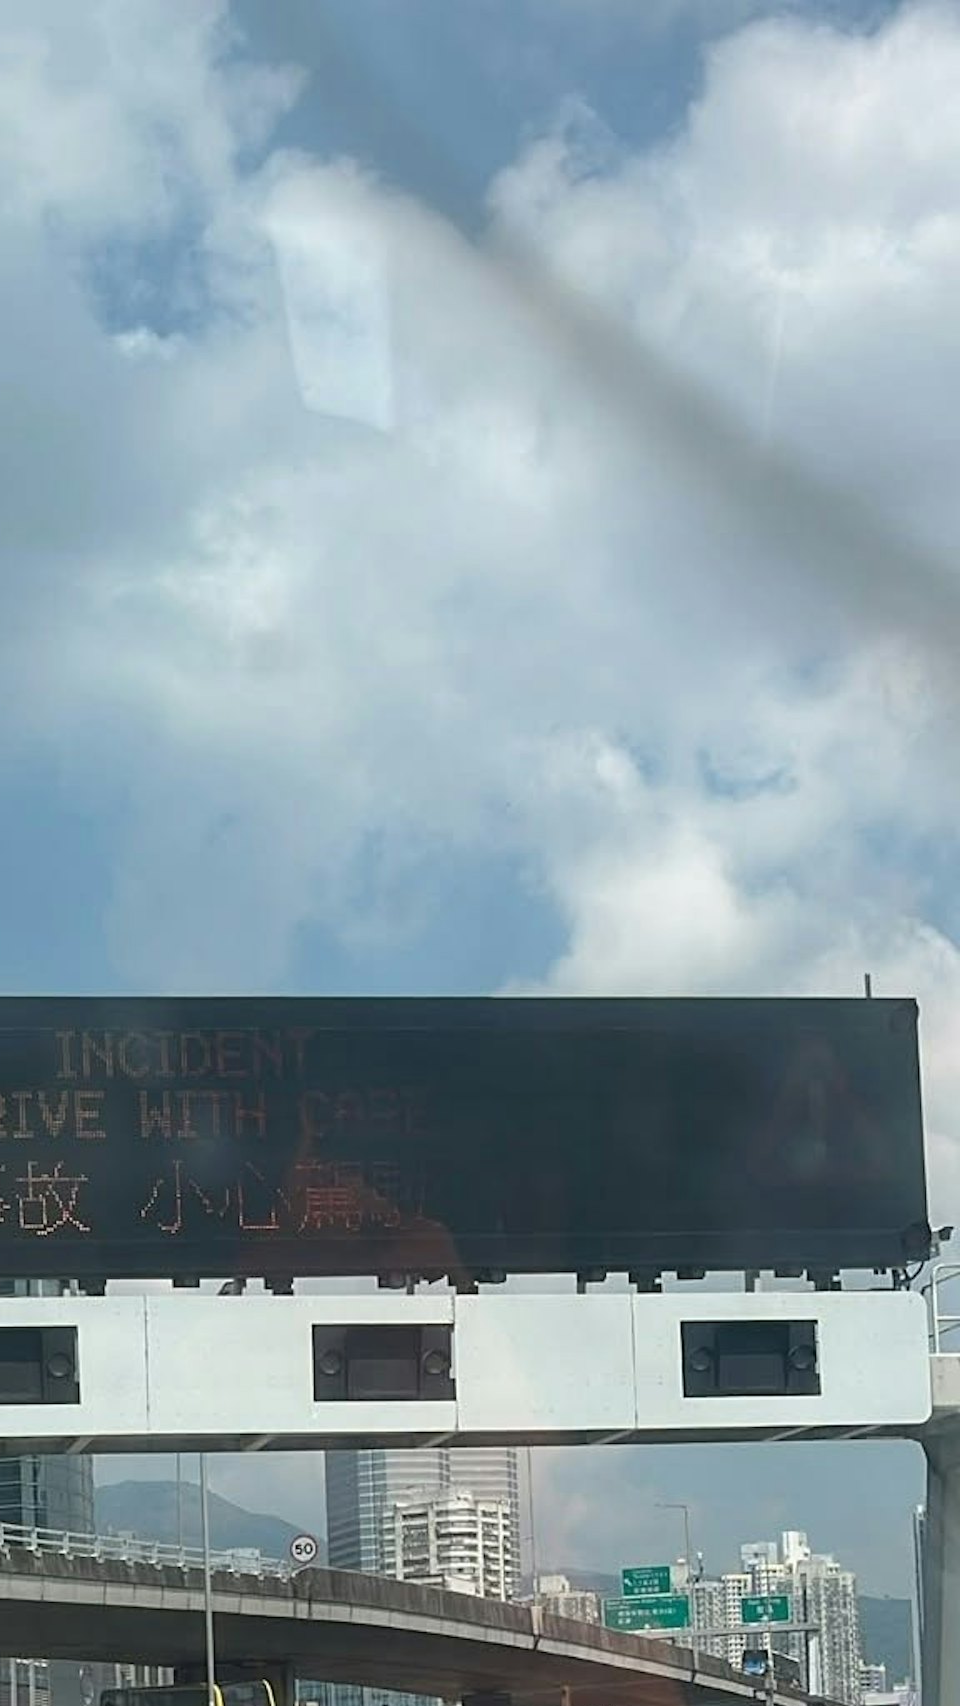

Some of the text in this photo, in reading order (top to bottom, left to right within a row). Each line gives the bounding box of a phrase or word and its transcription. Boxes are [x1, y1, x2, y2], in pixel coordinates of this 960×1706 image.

[55, 1029, 315, 1080] INCIDENT
[140, 1090, 266, 1139] WITH
[295, 1543, 313, 1555] 50
